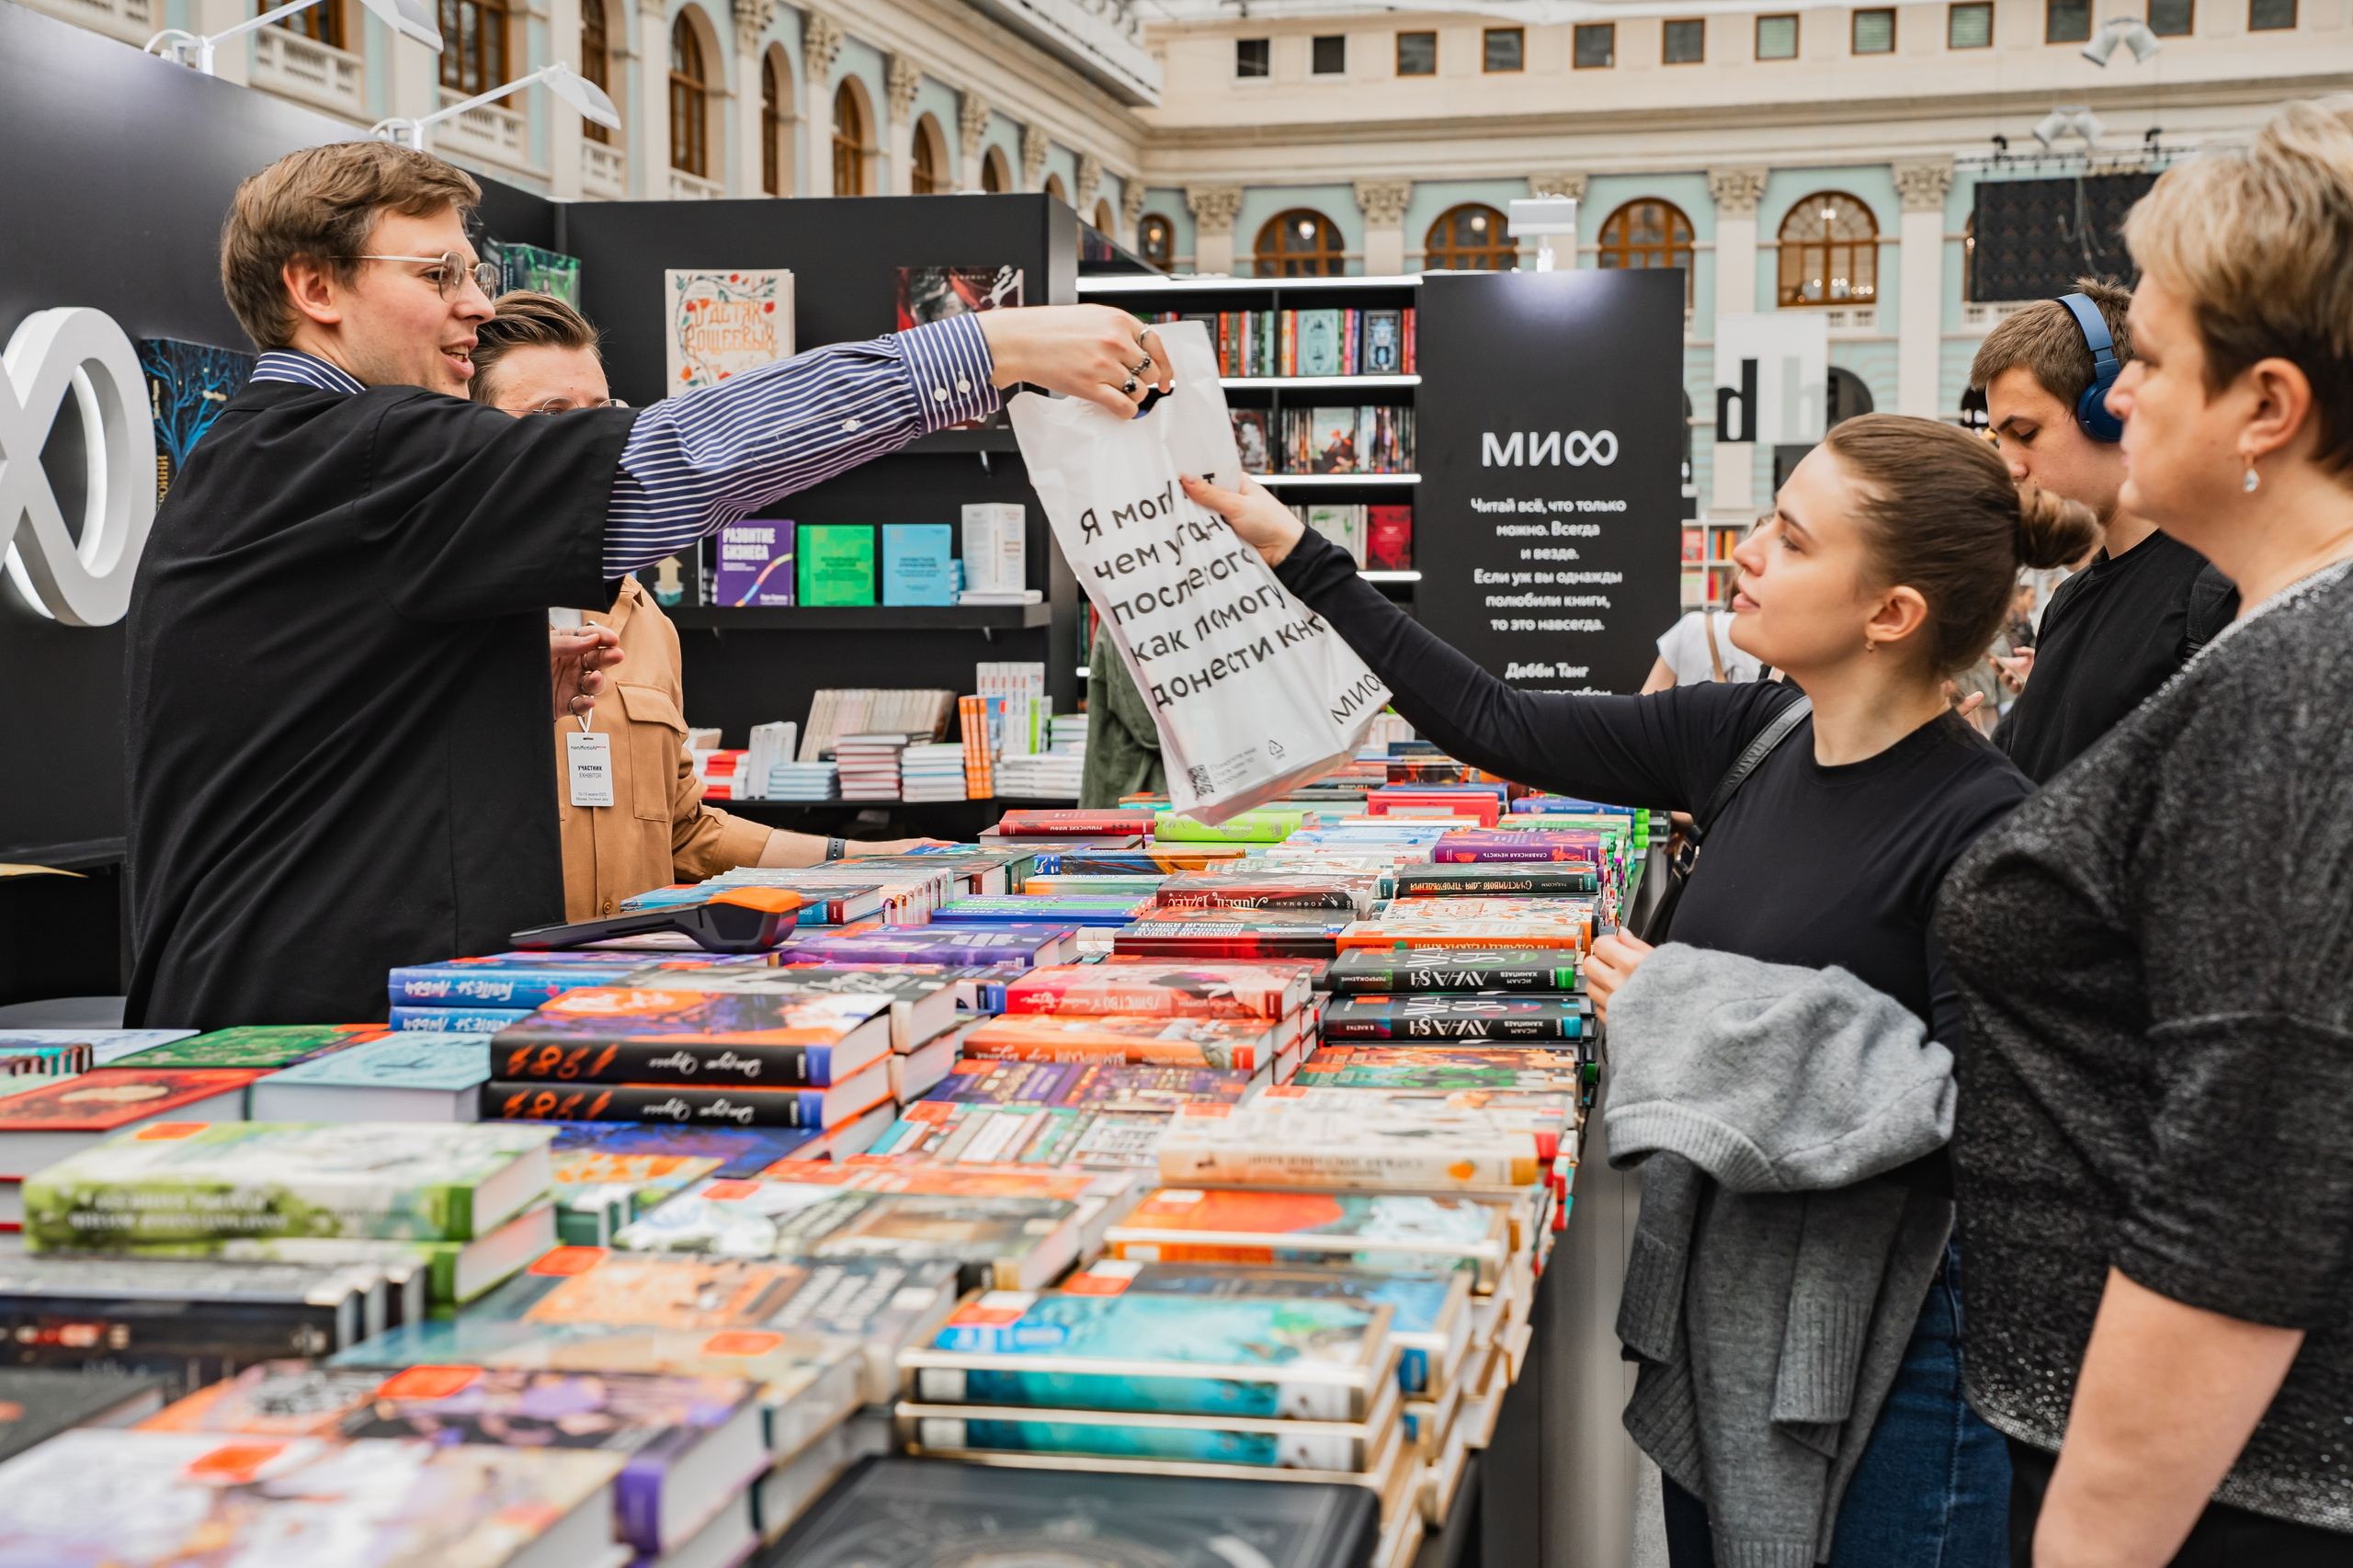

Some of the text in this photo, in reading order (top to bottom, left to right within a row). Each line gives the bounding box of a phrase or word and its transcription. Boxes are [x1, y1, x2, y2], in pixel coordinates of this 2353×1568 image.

[1471, 497, 1627, 514] Читай всё, что только
[1080, 507, 1103, 545] Я
[1496, 520, 1600, 537] можно. Всегда
[1094, 544, 1160, 581] чем
[1520, 548, 1580, 561] и везде.
[1473, 568, 1622, 586] Если уж вы однажды
[1485, 592, 1611, 608] полюбили книги,
[1490, 619, 1606, 632] то это навсегда.
[1130, 630, 1190, 666] как
[1150, 636, 1276, 713] донести
[1505, 663, 1589, 679] Дебби Танг
